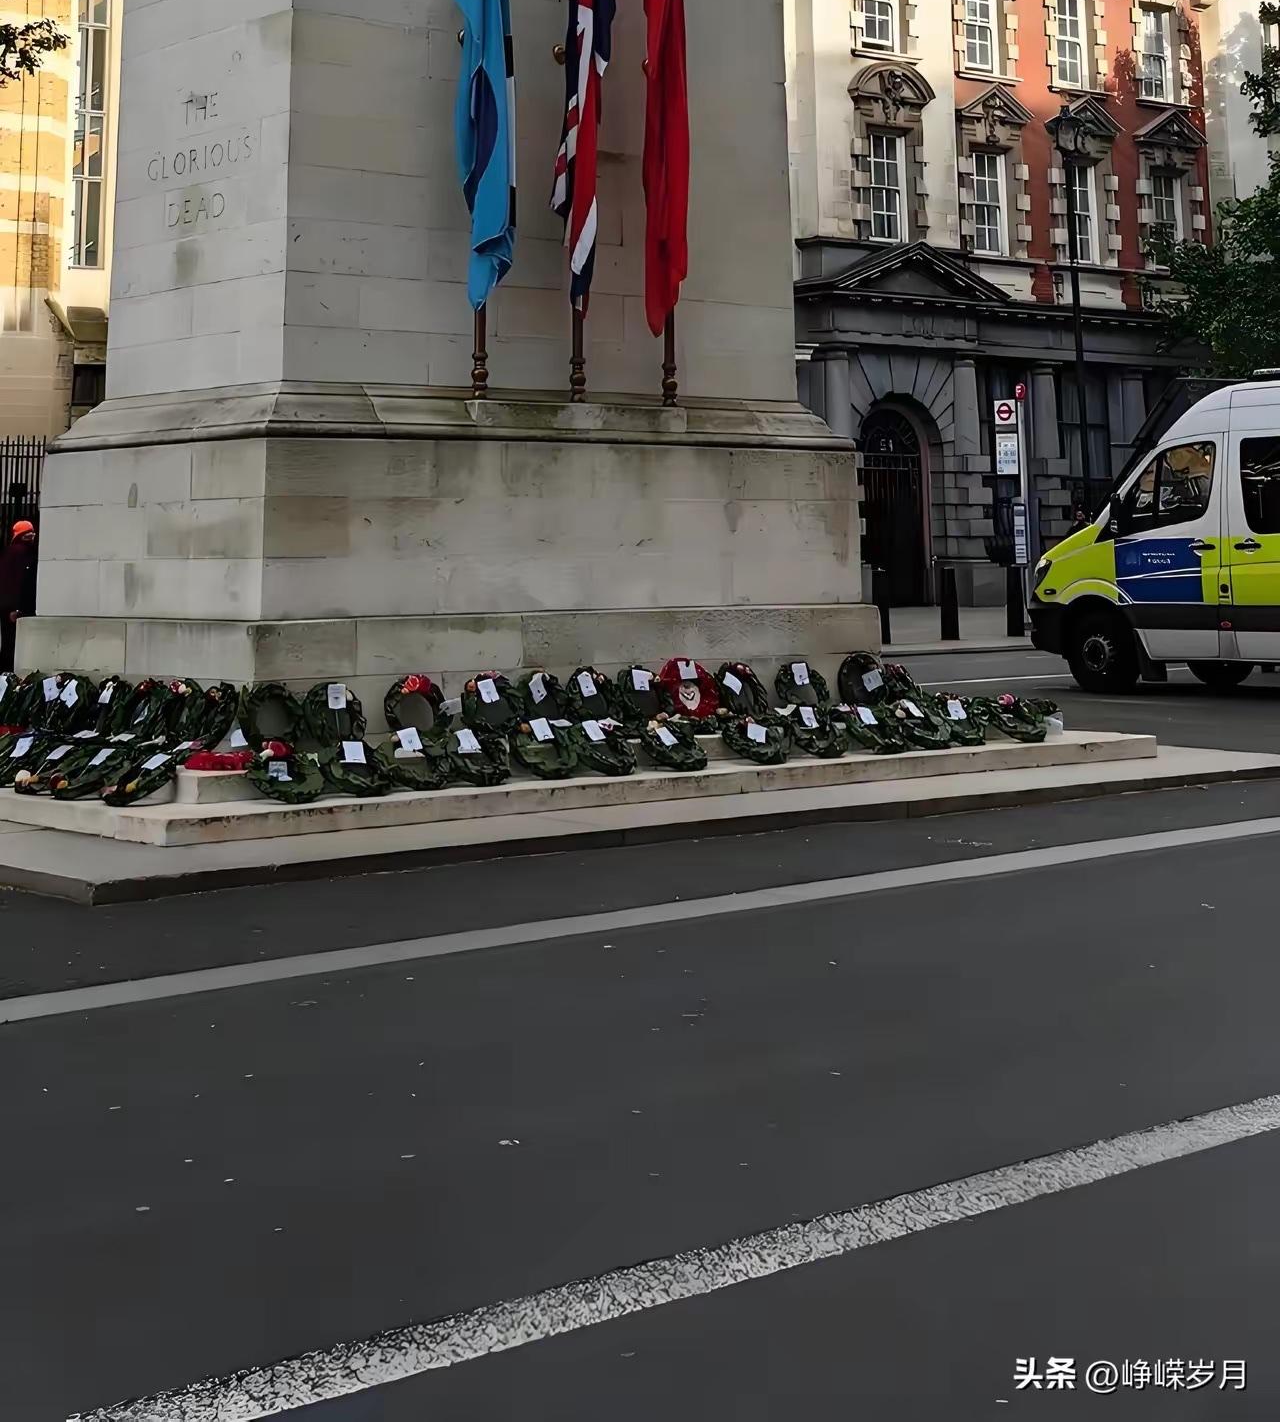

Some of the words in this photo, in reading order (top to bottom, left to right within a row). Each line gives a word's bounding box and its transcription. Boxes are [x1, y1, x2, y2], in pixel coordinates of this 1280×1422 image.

[181, 92, 218, 128] THE
[147, 135, 254, 181] GLORIOUS
[168, 192, 226, 228] DEAD
